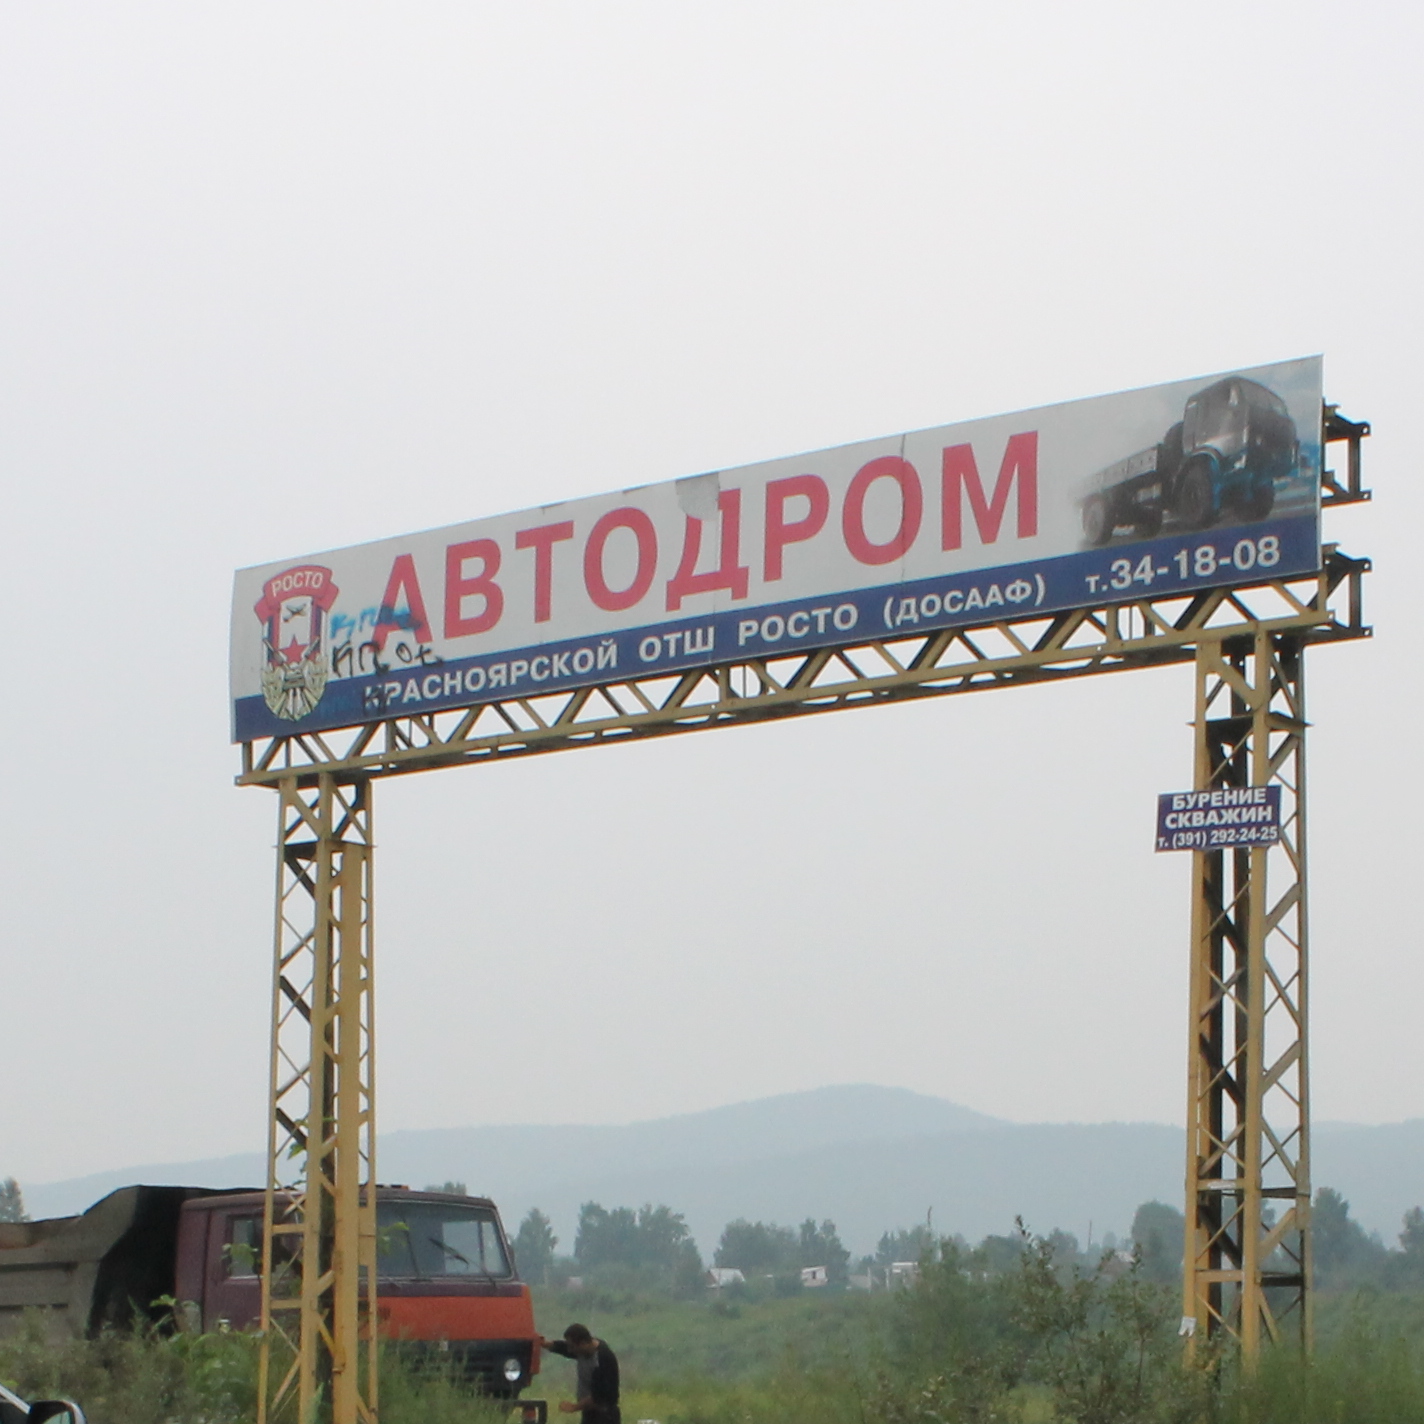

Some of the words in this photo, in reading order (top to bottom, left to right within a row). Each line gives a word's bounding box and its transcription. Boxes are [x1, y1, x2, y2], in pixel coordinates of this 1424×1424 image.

[369, 430, 1039, 653] АВТОДРОМ
[271, 571, 323, 598] РОСТО
[638, 625, 715, 663] ОТШ
[738, 603, 859, 646] РОСТО
[883, 573, 1046, 628] (ДОСААФ)
[1084, 535, 1281, 594] т.34-18-08
[1172, 788, 1267, 811] БУРЕНИЕ
[1165, 805, 1273, 829] СКВАЖИН
[1158, 837, 1169, 848] т.
[1172, 831, 1208, 849] (391)
[1210, 826, 1278, 845] 292-24-25
